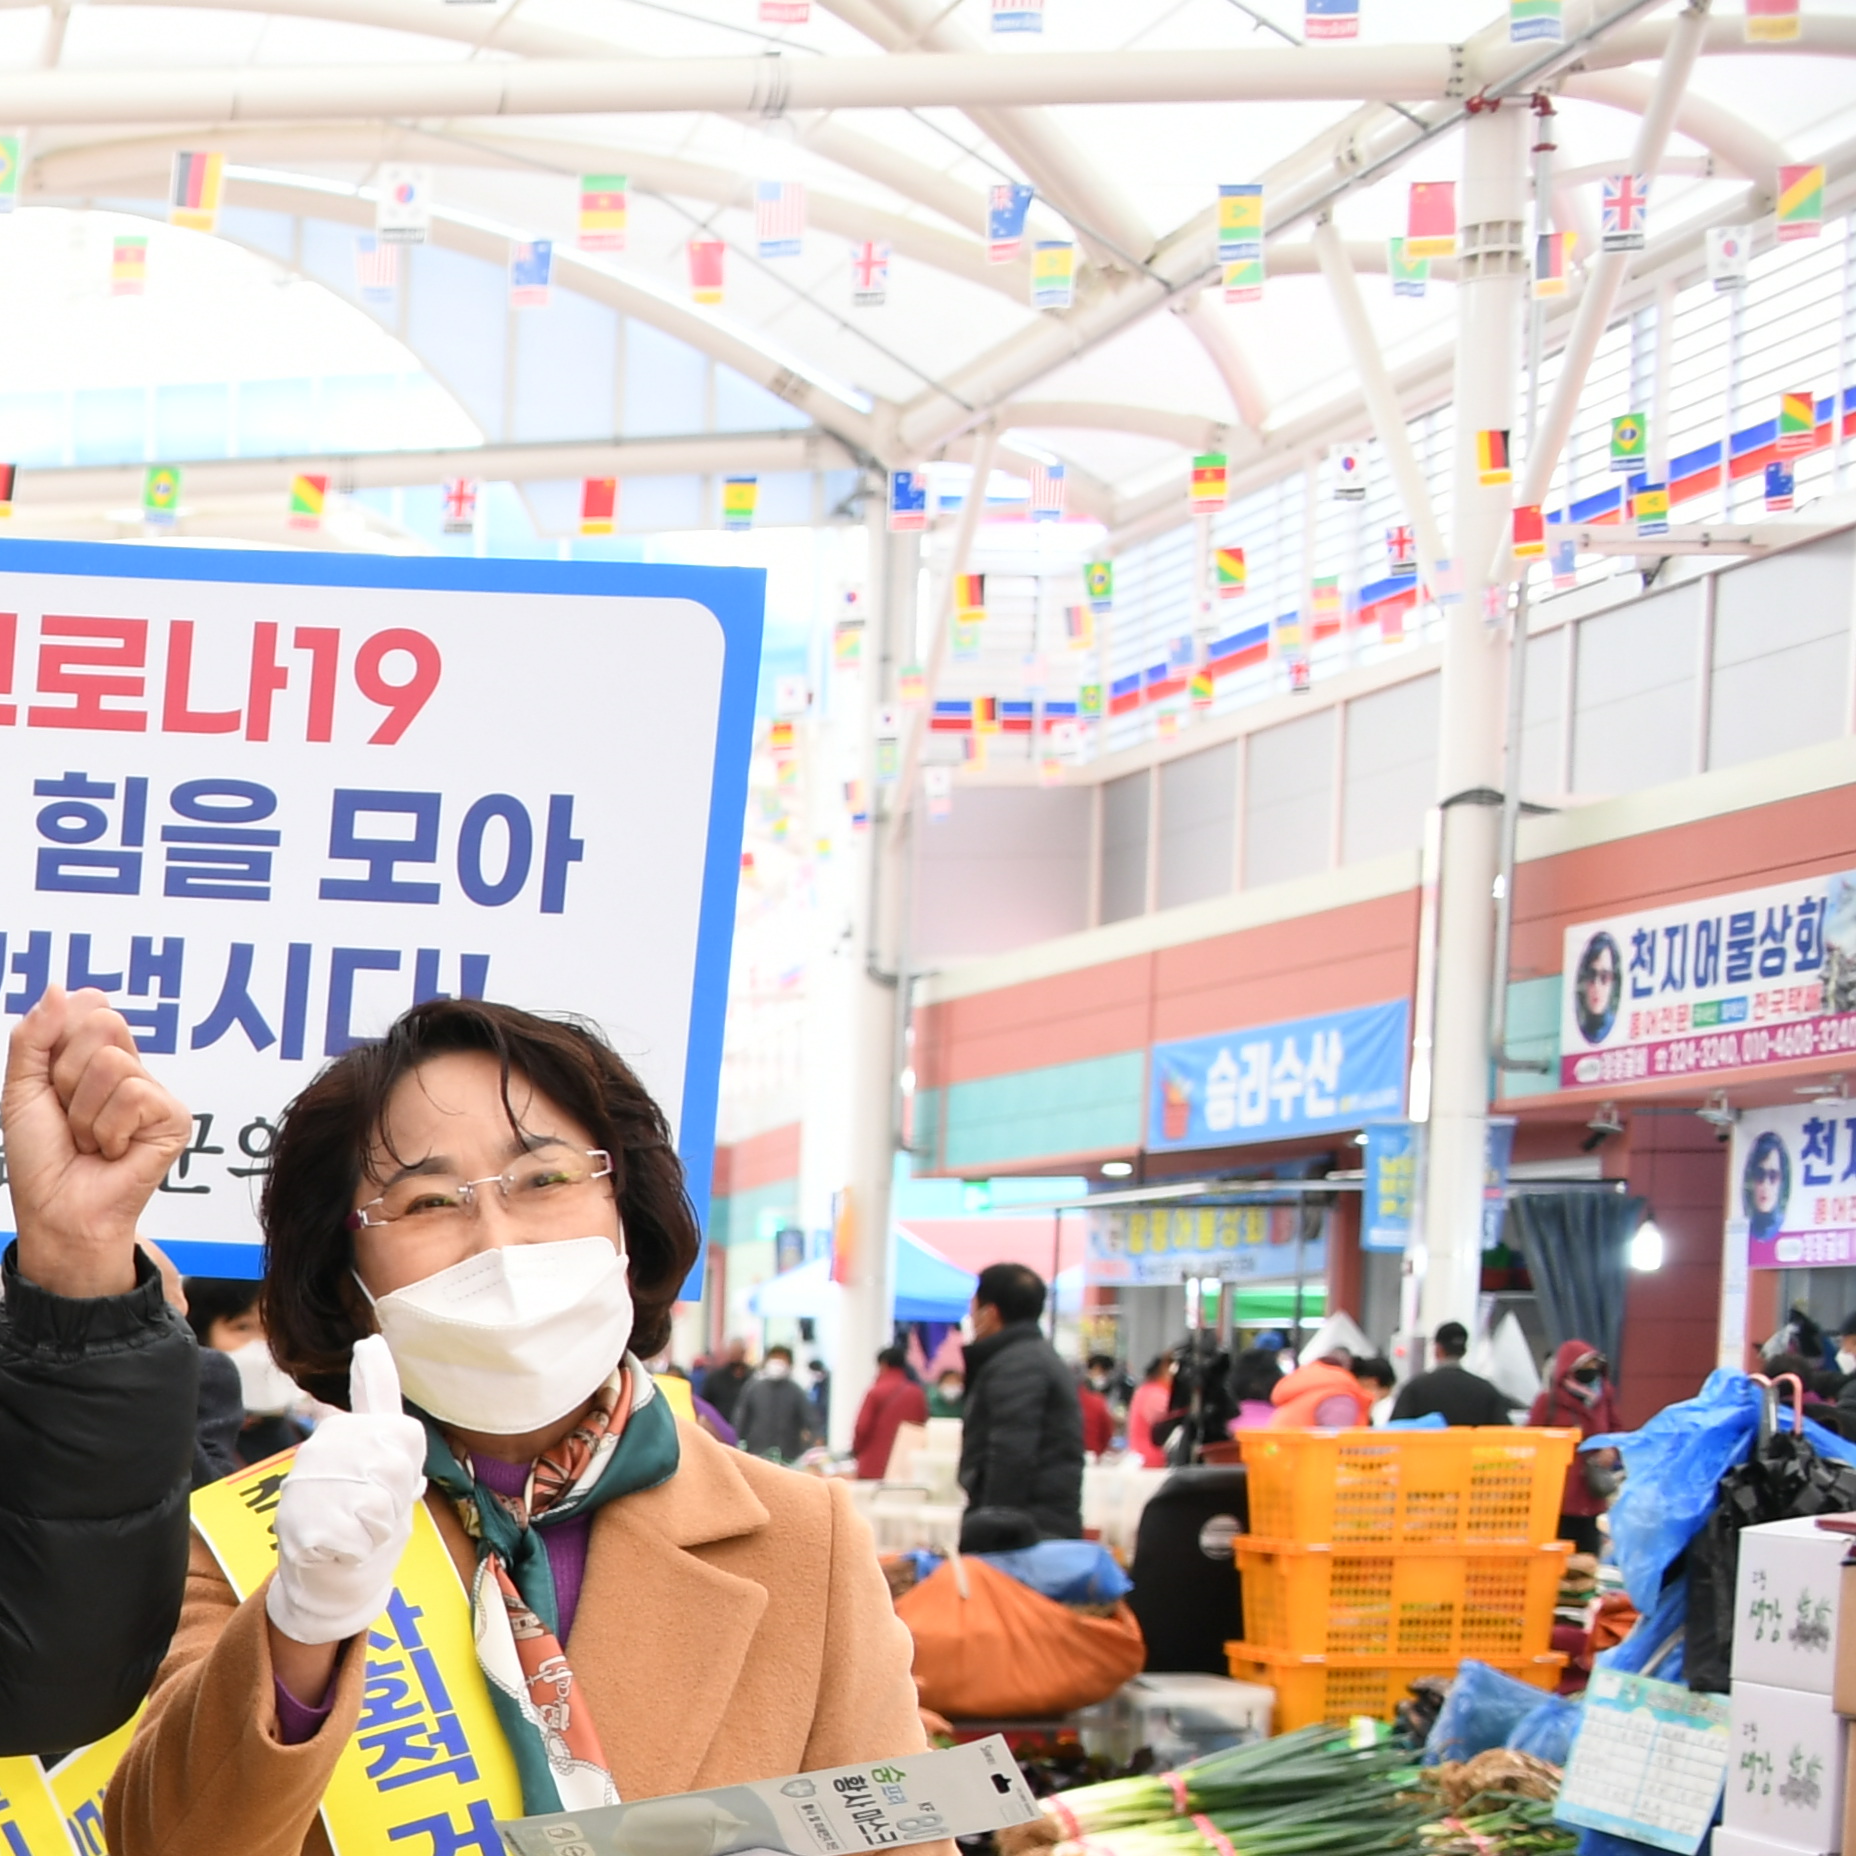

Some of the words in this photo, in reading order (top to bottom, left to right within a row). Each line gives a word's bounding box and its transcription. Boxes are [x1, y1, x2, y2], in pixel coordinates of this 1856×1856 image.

[32, 770, 282, 902] 힘을
[318, 786, 586, 915] 모아
[1629, 896, 1829, 999] 천지어물상회
[1205, 1029, 1342, 1132] 승리수산
[832, 1772, 870, 1812] 황사
[850, 1804, 897, 1849] 마스크
